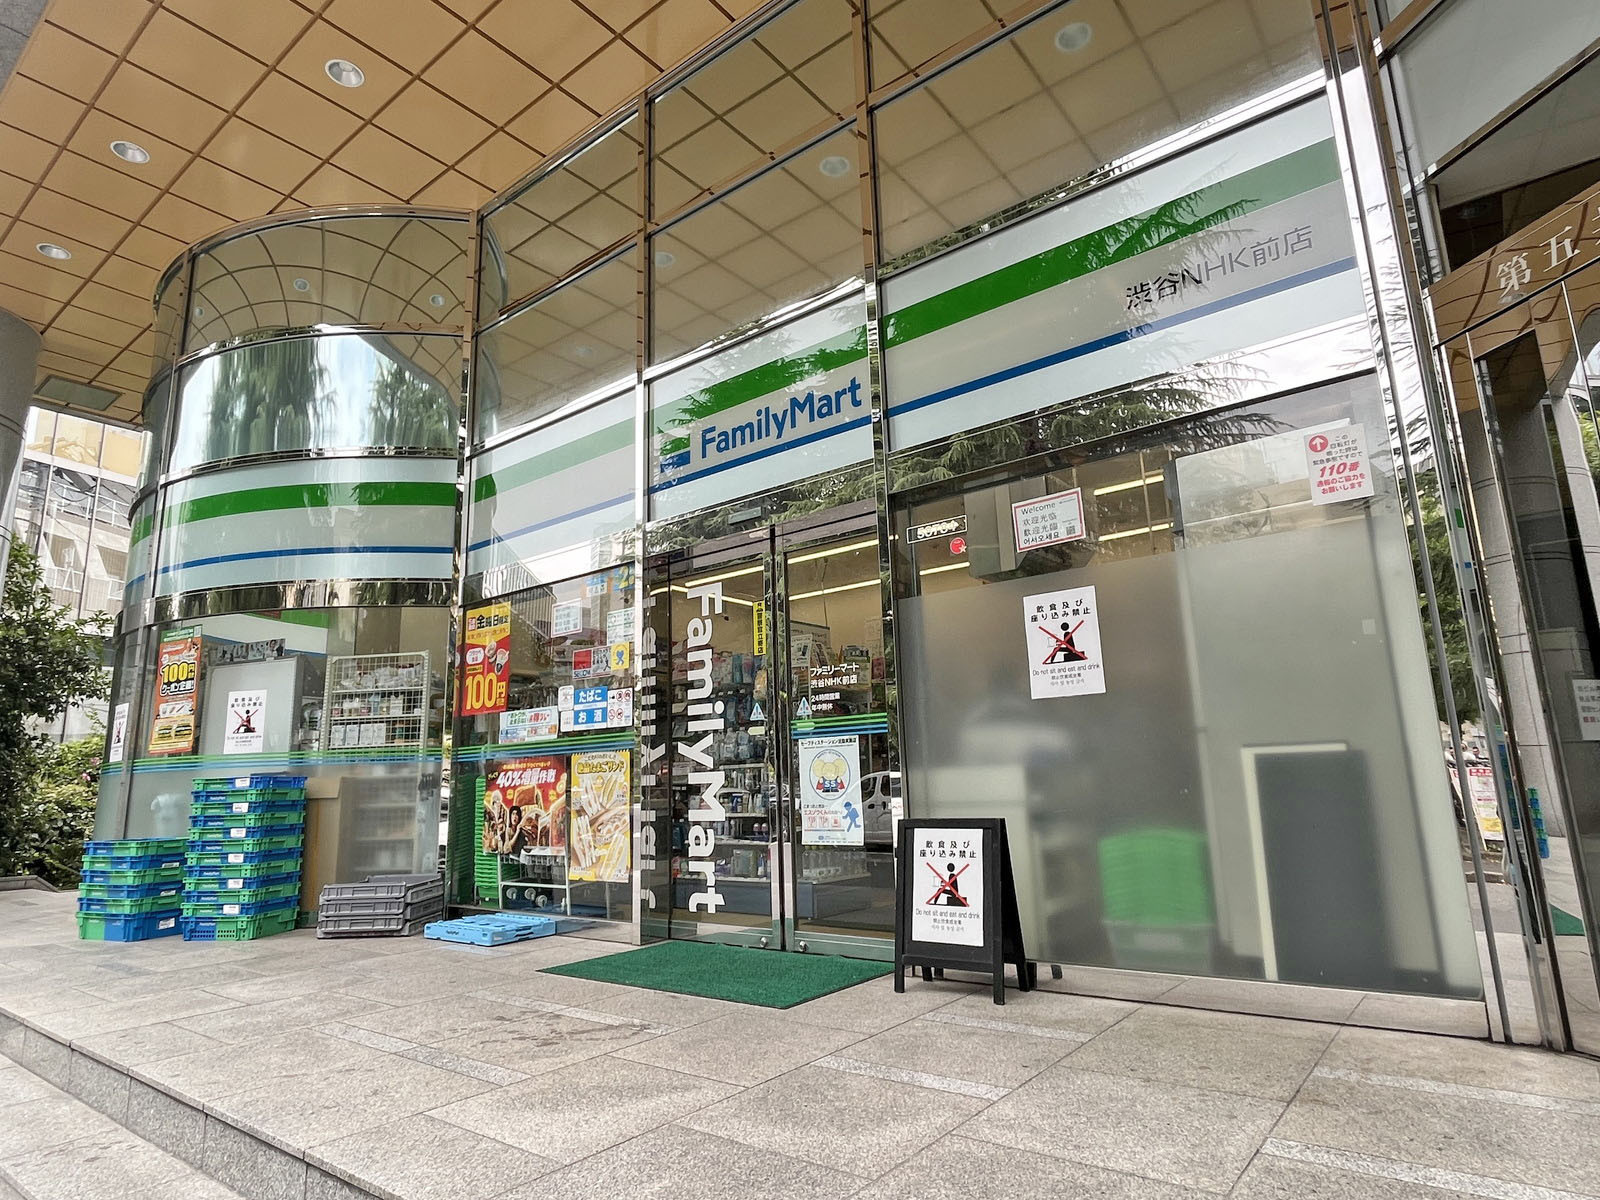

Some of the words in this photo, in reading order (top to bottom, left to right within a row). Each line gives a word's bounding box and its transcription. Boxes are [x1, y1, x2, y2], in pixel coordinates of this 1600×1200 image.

[1497, 207, 1600, 298] 第五
[1126, 225, 1313, 310] 渋谷NHK前店
[702, 377, 862, 459] FamilyMart
[1319, 461, 1360, 478] 110番
[1321, 481, 1364, 494] お願いします
[1021, 503, 1056, 515] Welcome
[1036, 598, 1083, 613] 飲食及び
[1030, 607, 1091, 622] 座り込み禁止
[810, 662, 859, 677] ファミリーマート
[811, 675, 857, 688] 渋谷NHK前店
[579, 689, 602, 702] たばこ
[578, 709, 602, 723] お酒
[677, 582, 725, 914] FamilyMart
[496, 767, 557, 788] 40%増量作戦
[824, 780, 836, 788] SS
[926, 840, 971, 849] 飲食及び
[919, 849, 977, 859] 座り込み禁止
